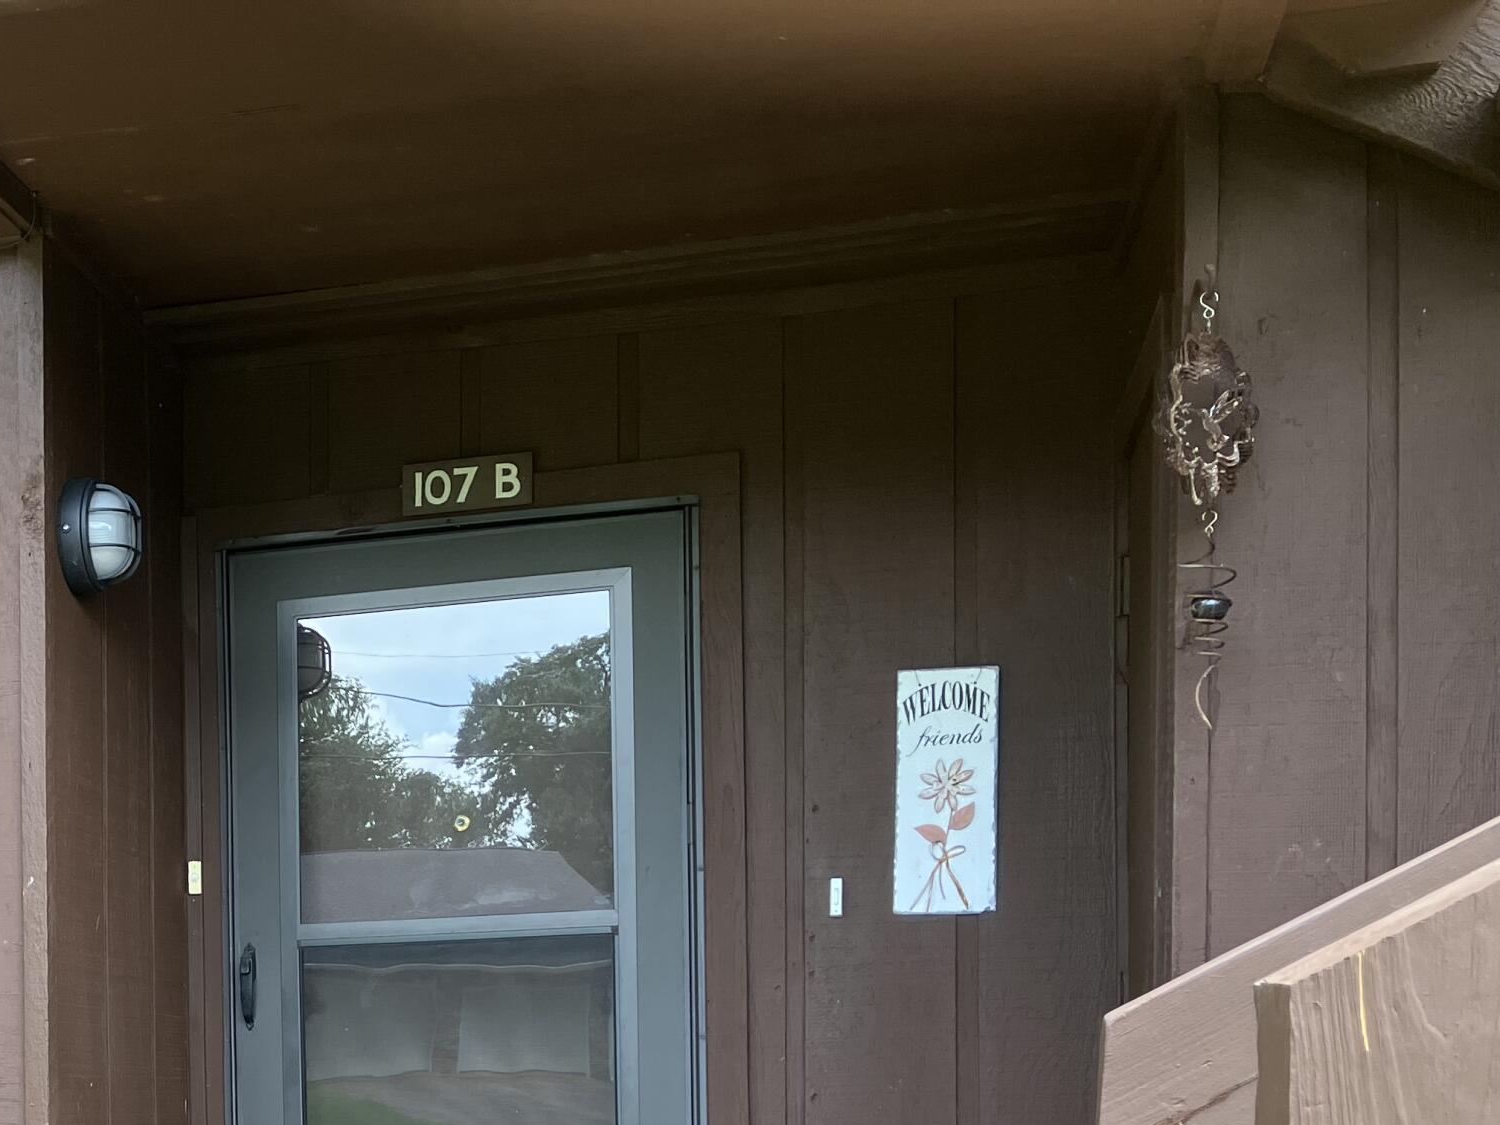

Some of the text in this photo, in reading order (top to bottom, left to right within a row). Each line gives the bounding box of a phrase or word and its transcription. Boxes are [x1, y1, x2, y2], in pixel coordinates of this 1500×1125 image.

[414, 462, 521, 507] 107 B
[902, 680, 991, 725] WELCOME
[905, 722, 983, 757] friends
